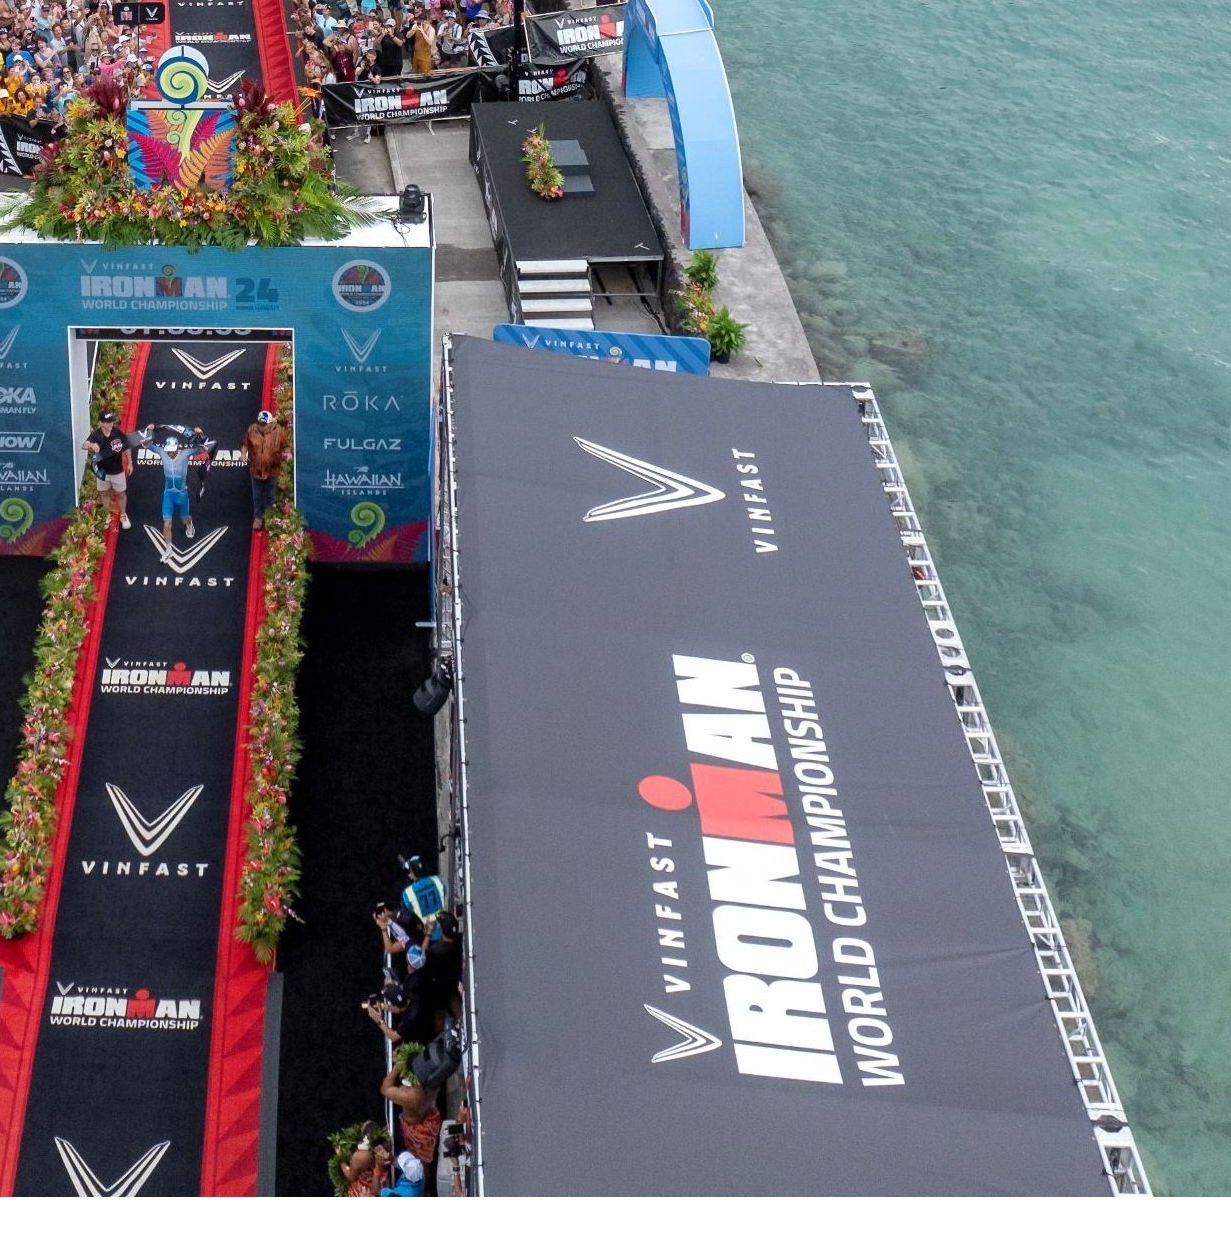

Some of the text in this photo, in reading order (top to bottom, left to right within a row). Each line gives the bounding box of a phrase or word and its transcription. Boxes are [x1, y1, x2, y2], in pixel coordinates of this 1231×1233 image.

[559, 44, 587, 54] WORLD
[354, 89, 448, 114] IRONMAN
[356, 105, 448, 121] WORLD CHAMPIONSHIP
[102, 262, 155, 270] VINFAST
[80, 270, 279, 303] IRONMAN 24
[82, 299, 128, 310] WORLD
[131, 300, 227, 311] CHAMPIONSHIP
[545, 338, 600, 351] VINFAST
[335, 365, 387, 373] VINFAST
[156, 381, 251, 390] VINFAST
[323, 391, 401, 411] RŌKA
[22, 406, 37, 414] FLY
[324, 438, 402, 450] FULGAZ
[324, 468, 403, 491] HAWAIIAN
[732, 447, 778, 554] VINFAST
[125, 576, 234, 587] VINFAST
[101, 663, 231, 687] IRONMAN
[100, 685, 229, 695] WORLD CHAMPIONSHIP
[82, 862, 209, 876] VINFAST
[656, 654, 843, 1085] IRONMAN
[774, 666, 905, 1087] WORLD CHAMPIONSHIP
[647, 831, 690, 994] VINFAST
[77, 986, 128, 995] VINFAST
[51, 990, 201, 1020] IRONMAN
[49, 1016, 199, 1030] WORLD CHAMPIONSHIP
